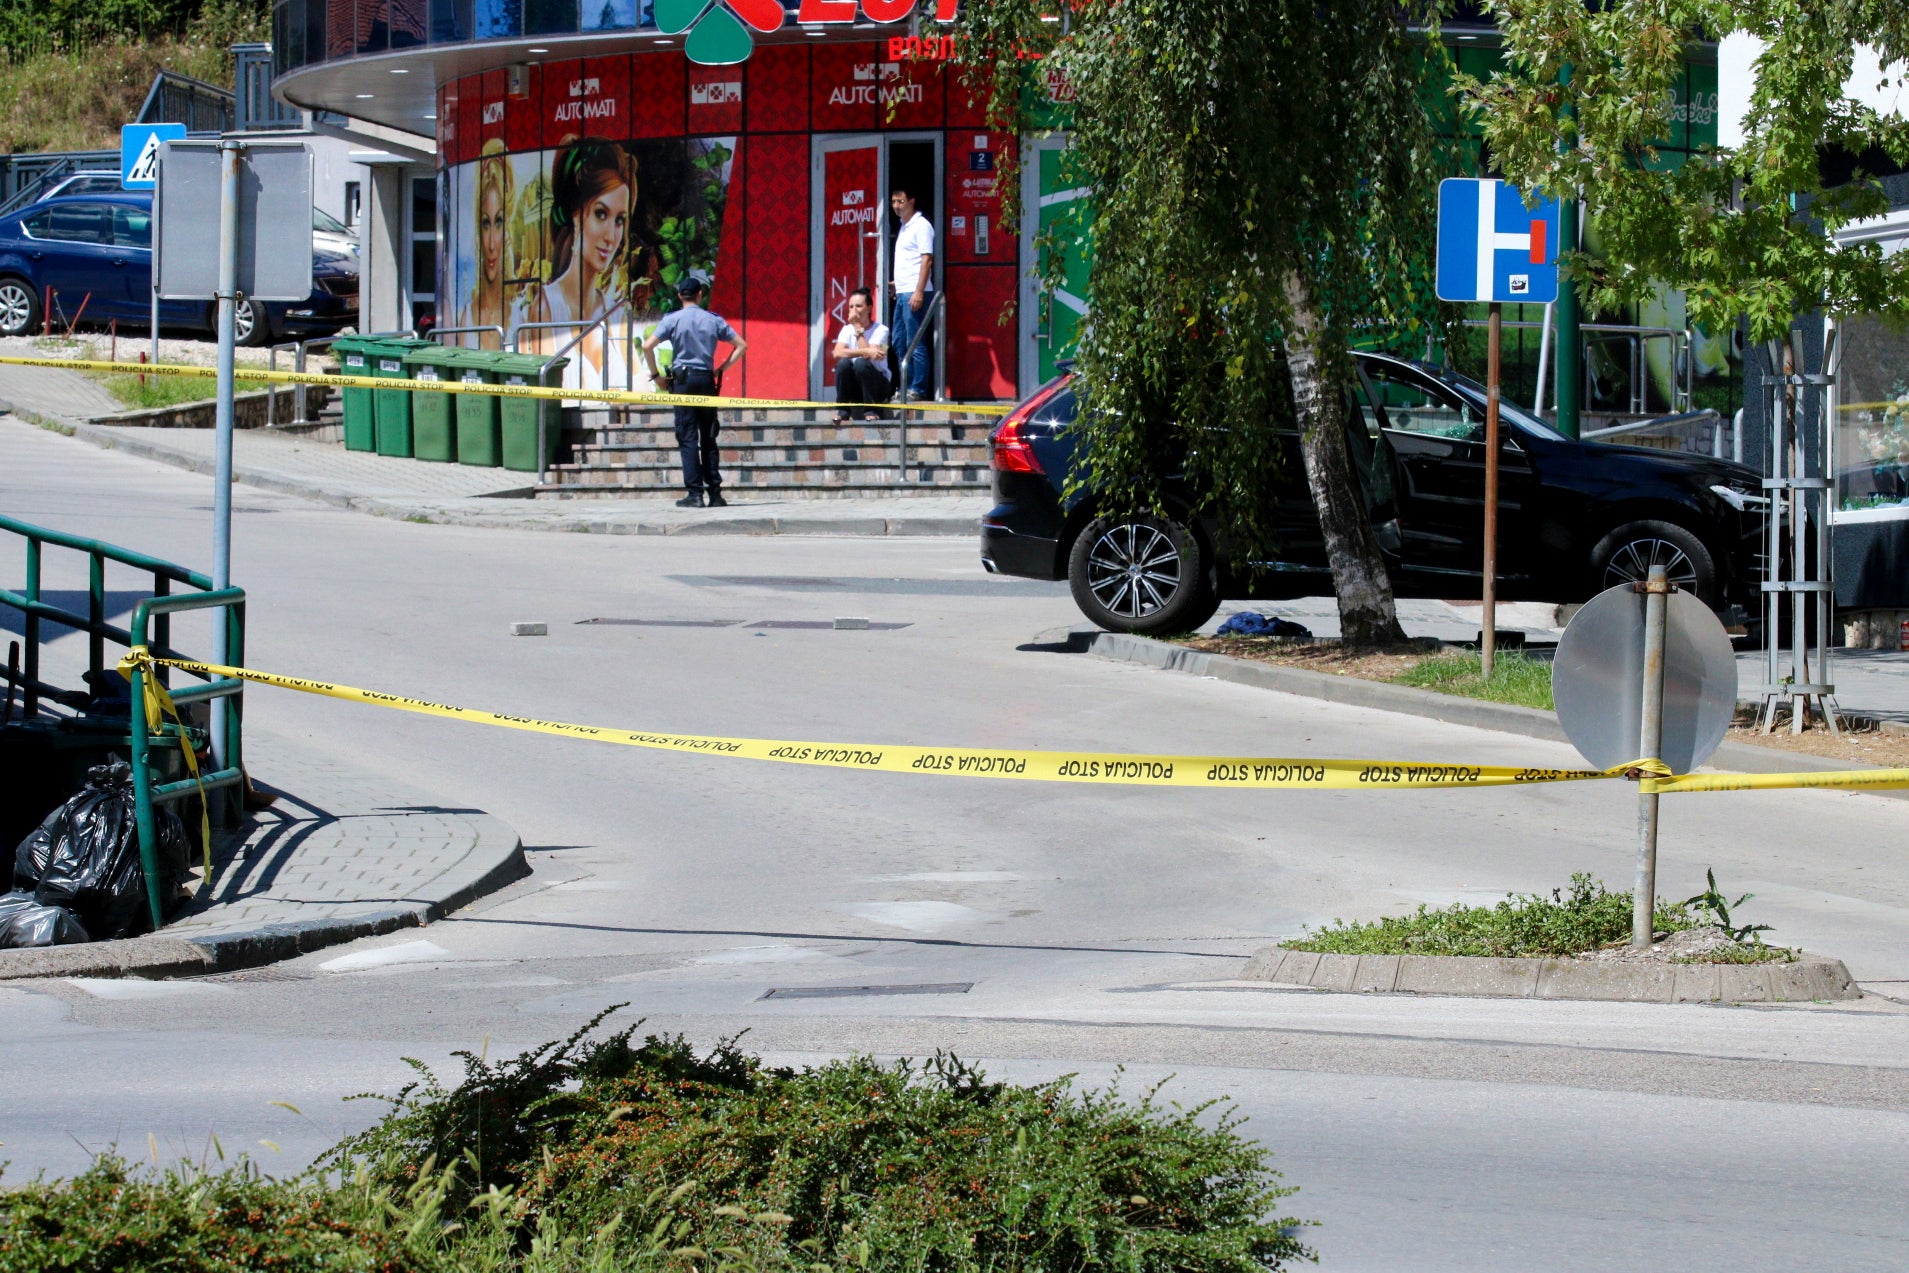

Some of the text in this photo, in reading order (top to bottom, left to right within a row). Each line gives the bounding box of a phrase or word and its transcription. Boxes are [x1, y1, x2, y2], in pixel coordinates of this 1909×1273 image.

[828, 84, 923, 105] AUTOMATI
[554, 98, 616, 122] AUTOMATI
[978, 153, 985, 163] 2
[831, 207, 875, 226] AUTOMATI
[111, 365, 180, 376] POLICIJA STOP
[243, 372, 269, 381] STOP
[287, 375, 357, 386] POLICIJA STOP
[375, 380, 444, 391] POLICIJA STOP
[464, 385, 533, 396] POLICIJA STOP
[552, 390, 622, 400] POLICIJA STOP
[640, 394, 710, 404] POLICIJA STOP
[673, 738, 743, 752] POLICIJA
[768, 746, 883, 765] POLICIJA STOP
[911, 754, 1027, 773] POLICIJA STOP
[1058, 760, 1174, 779] POLICIJA STOP
[1207, 764, 1325, 782] POLICIJA STOP
[1359, 766, 1481, 782] POLICIJA STOP
